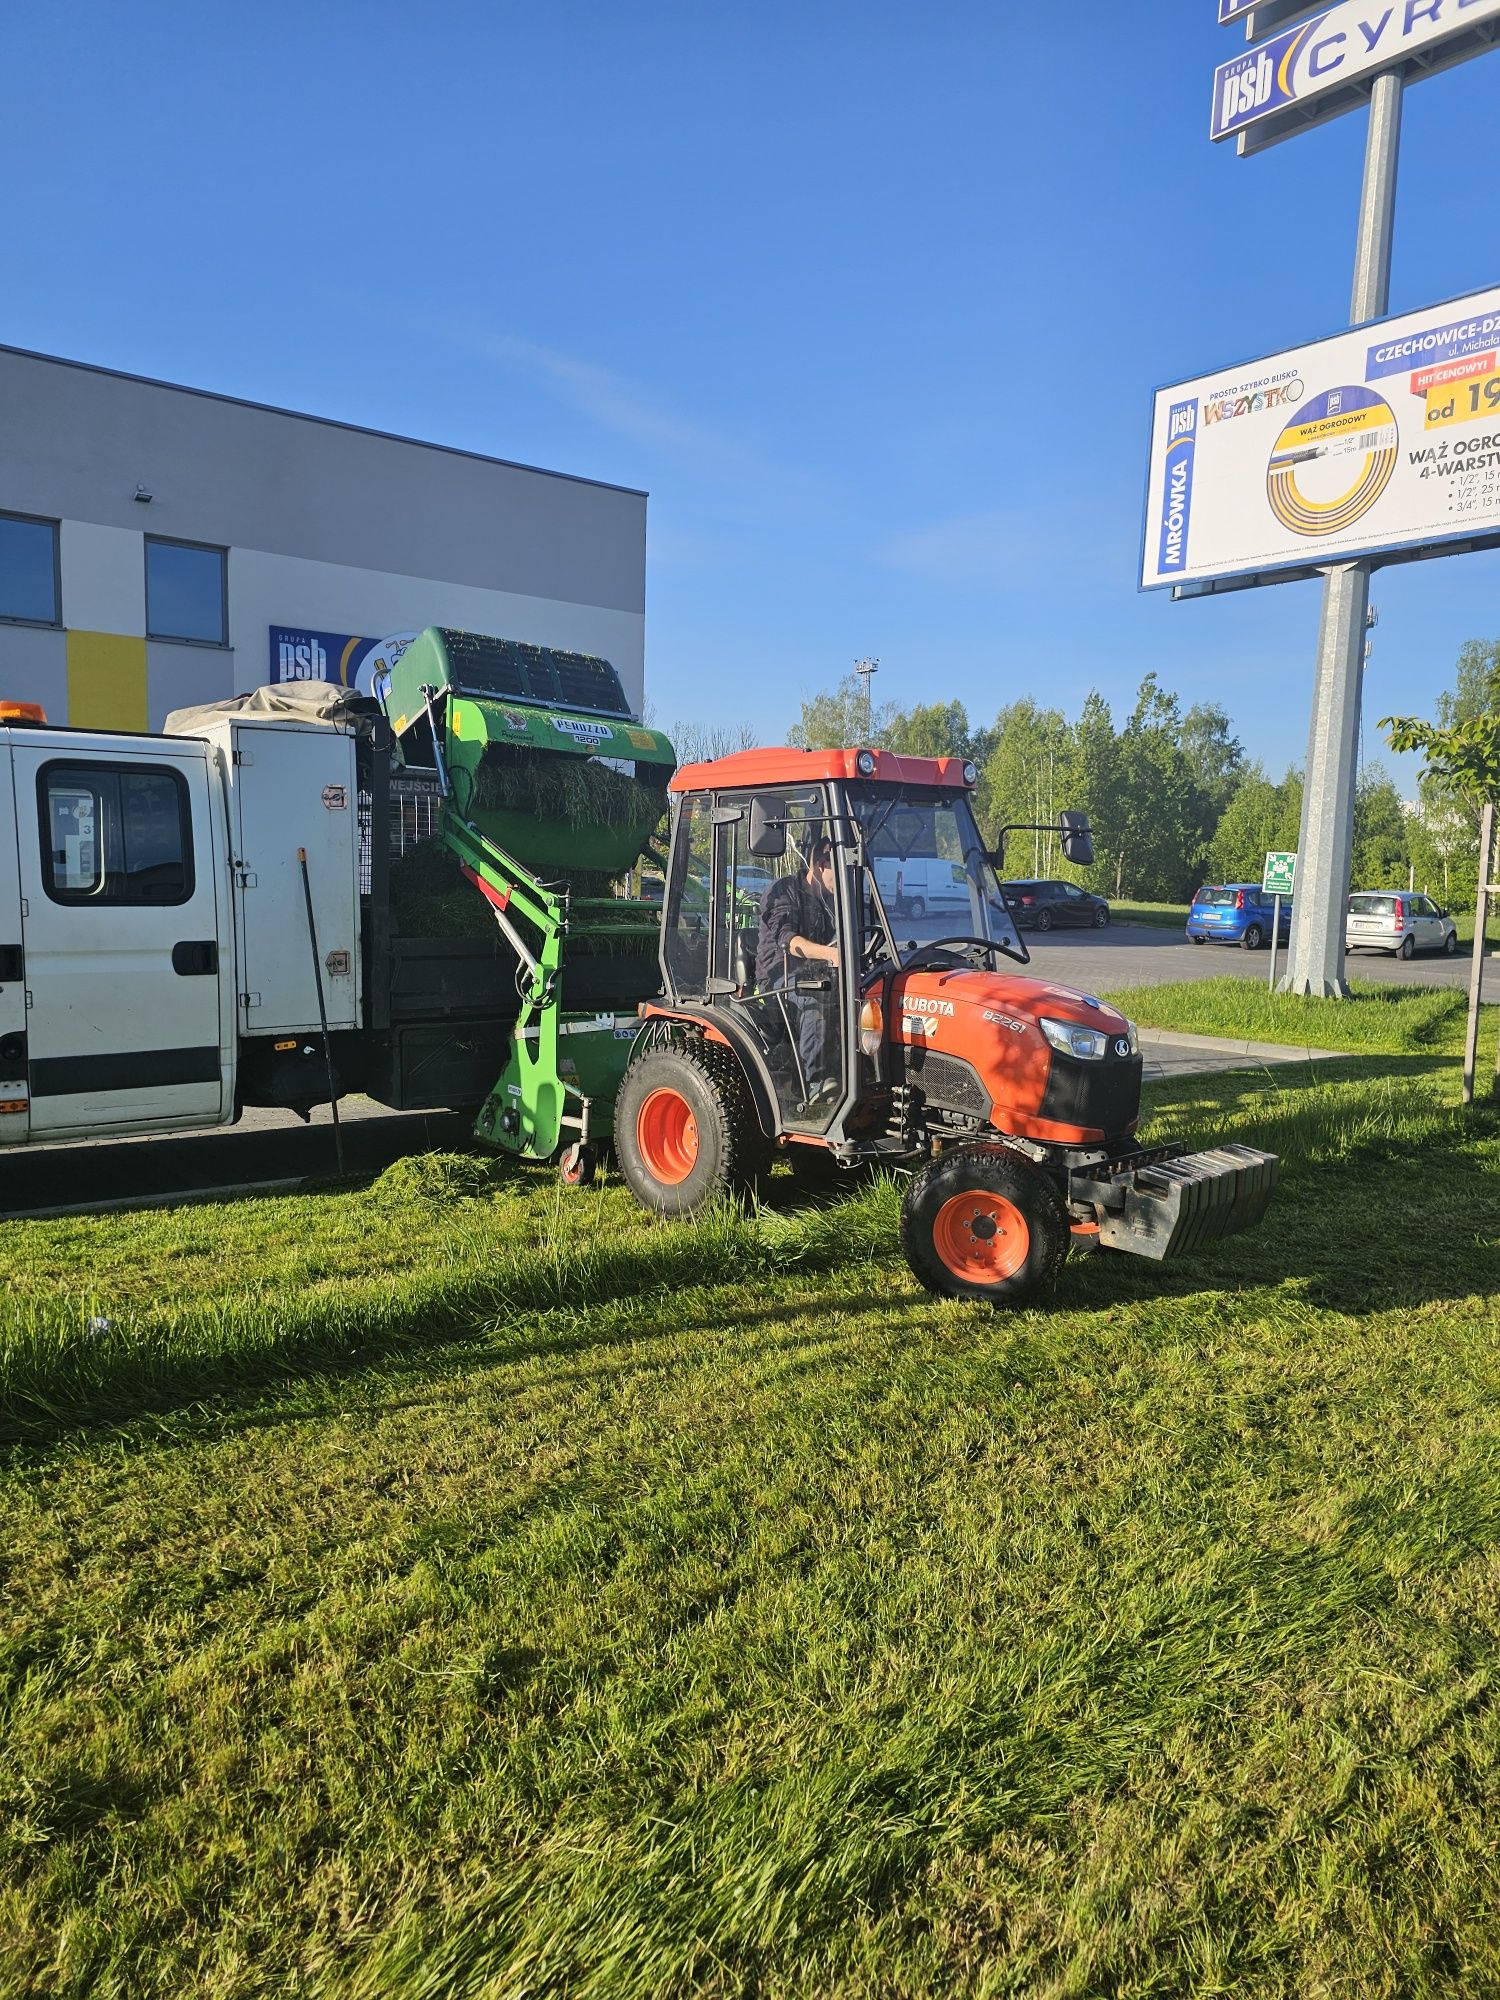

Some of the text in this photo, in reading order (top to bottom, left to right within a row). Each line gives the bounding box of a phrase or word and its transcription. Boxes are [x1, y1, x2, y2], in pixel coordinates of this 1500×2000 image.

[1308, 0, 1483, 78] CYR
[1224, 58, 1252, 79] GRUPA
[1220, 51, 1273, 129] psb
[1448, 344, 1459, 357] ul.
[1417, 360, 1487, 386] HIT CENOWY!
[1209, 369, 1298, 401] PROSTO SZYBKO BLISKO
[1427, 399, 1455, 421] od
[1170, 404, 1195, 440] psb
[1319, 414, 1367, 431] OGRODOWY
[1409, 441, 1449, 465] WĄŻ
[1485, 470, 1495, 480] 15
[1481, 484, 1493, 494] 25
[1164, 459, 1188, 564] MRÓWKA
[1483, 497, 1493, 507] 15
[278, 634, 306, 643] GRUPA
[279, 639, 327, 683] psb
[557, 720, 608, 735] PERUZZO
[575, 735, 599, 745] 1200
[899, 995, 955, 1017] KUBOTA
[982, 1010, 1027, 1034] B2261
